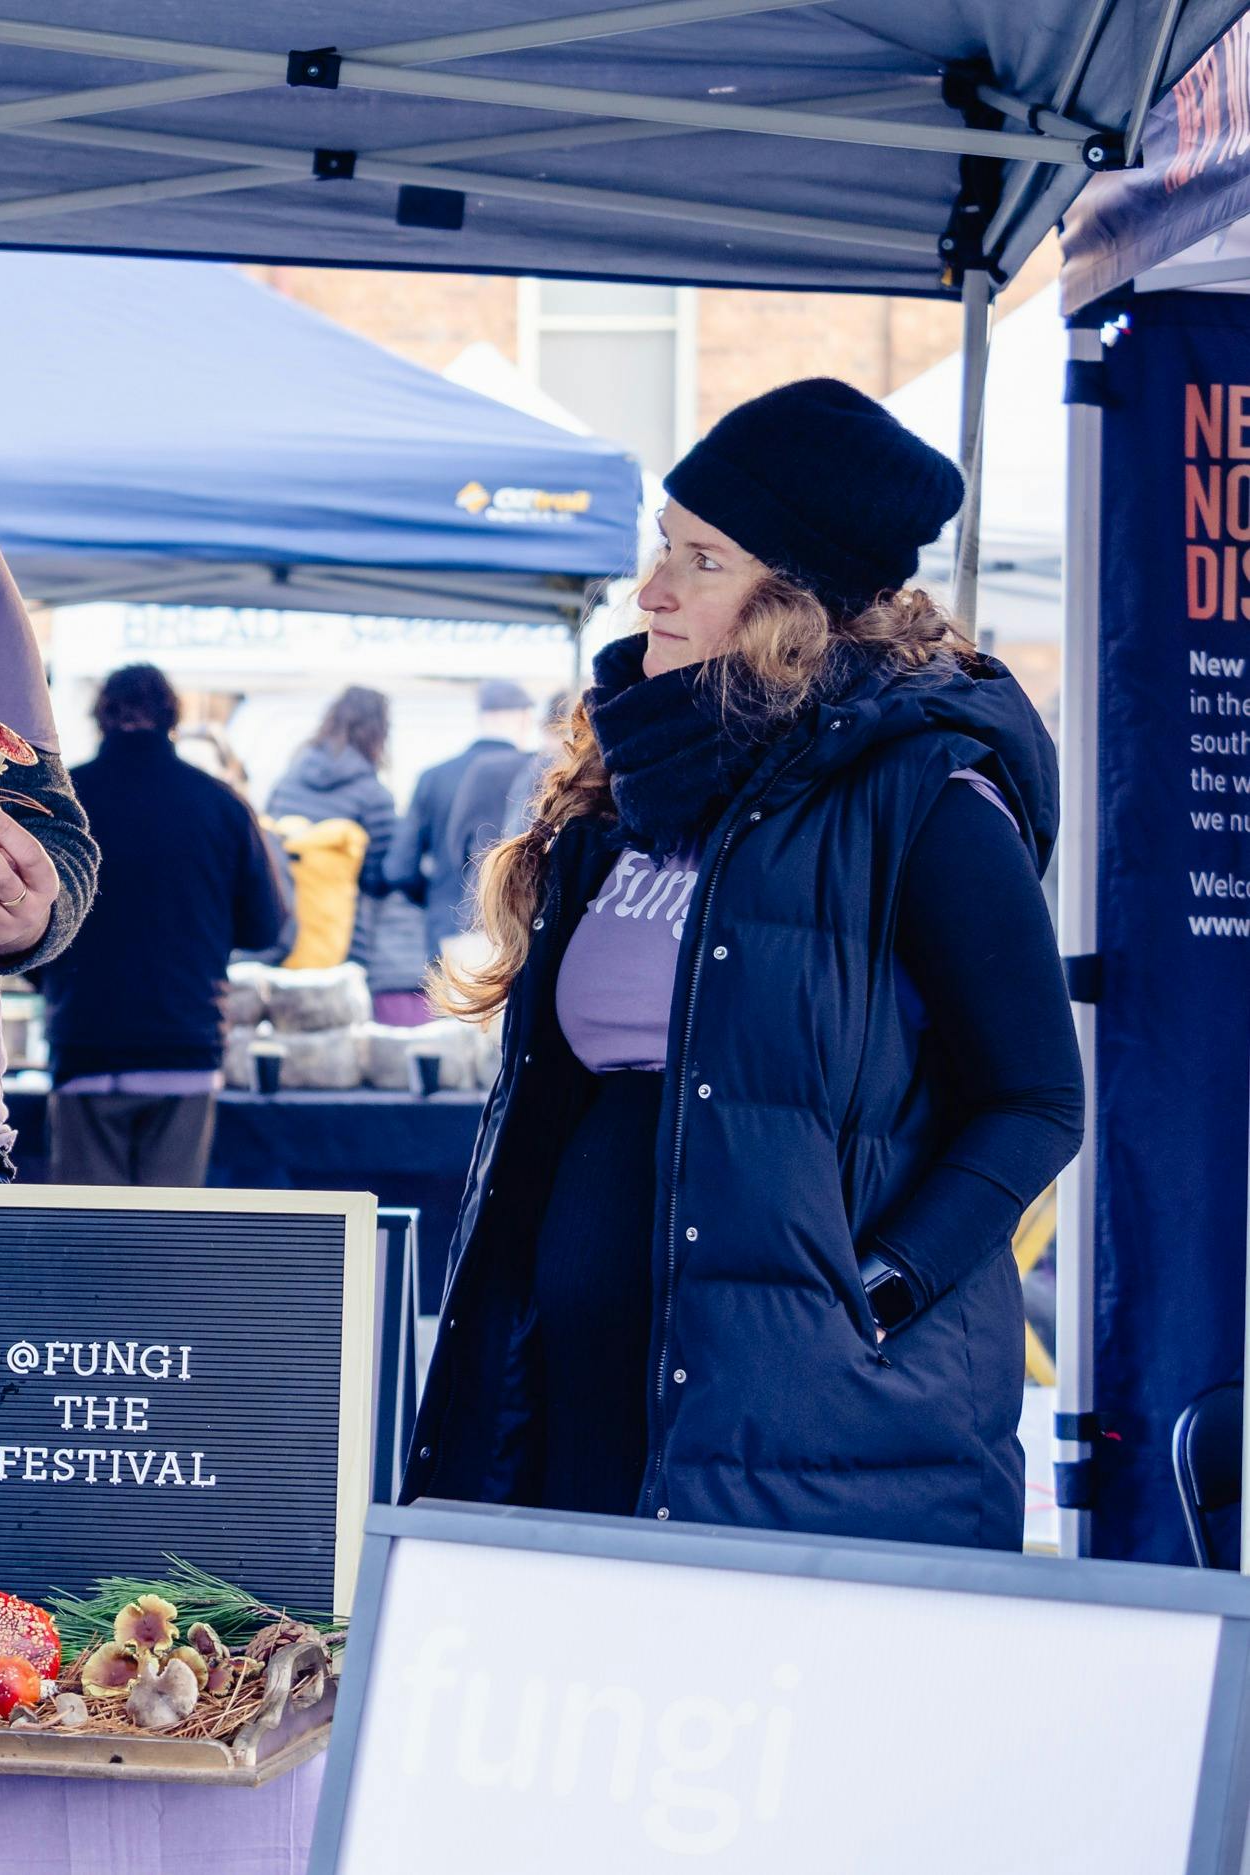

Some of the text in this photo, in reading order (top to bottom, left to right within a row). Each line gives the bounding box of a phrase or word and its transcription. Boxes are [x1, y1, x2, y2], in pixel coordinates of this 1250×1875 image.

[1184, 383, 1250, 460] NE
[1190, 649, 1245, 678] New
[1190, 688, 1250, 717] in the
[1190, 730, 1250, 755] south
[1190, 766, 1226, 793] the
[1190, 811, 1224, 832] we
[595, 851, 698, 940] fun
[6, 1340, 193, 1381] @FUNGI
[53, 1395, 150, 1433] THE
[397, 1625, 805, 1854] fungi
